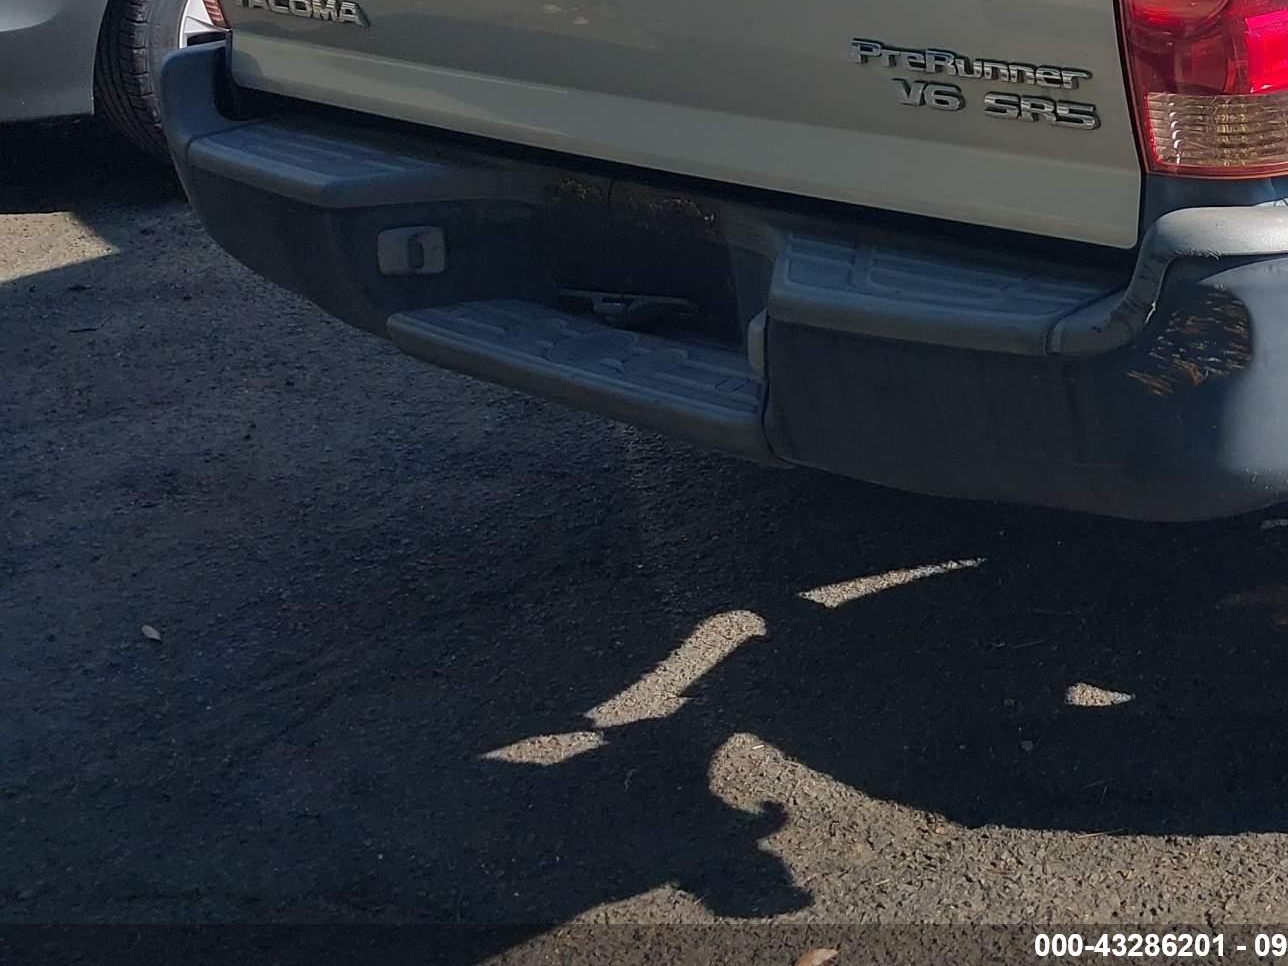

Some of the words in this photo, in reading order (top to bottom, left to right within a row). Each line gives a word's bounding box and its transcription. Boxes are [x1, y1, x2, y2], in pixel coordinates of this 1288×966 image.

[851, 37, 1092, 90] PreRunner
[891, 78, 965, 112] V6
[983, 91, 1101, 131] SR5
